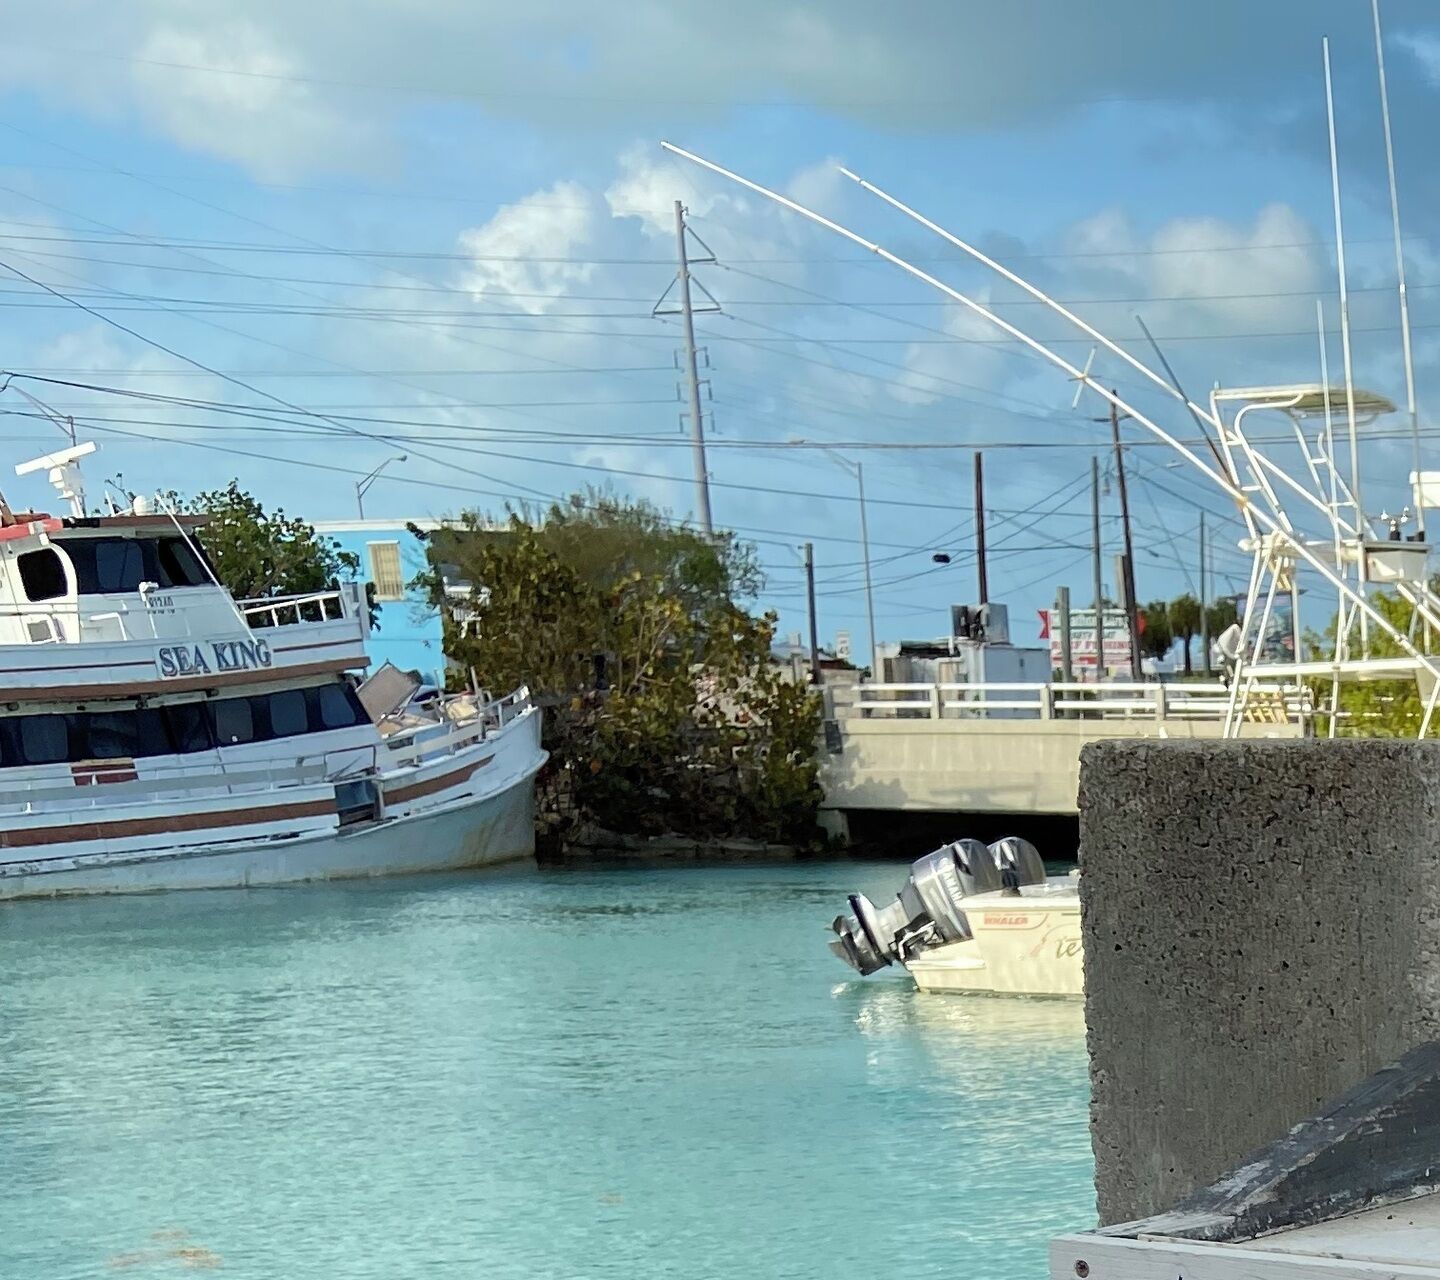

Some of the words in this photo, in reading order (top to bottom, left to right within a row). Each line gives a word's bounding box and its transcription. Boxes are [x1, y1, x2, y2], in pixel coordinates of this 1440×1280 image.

[159, 645, 211, 677] SEA
[212, 639, 272, 672] KING
[984, 917, 1028, 925] WHALER
